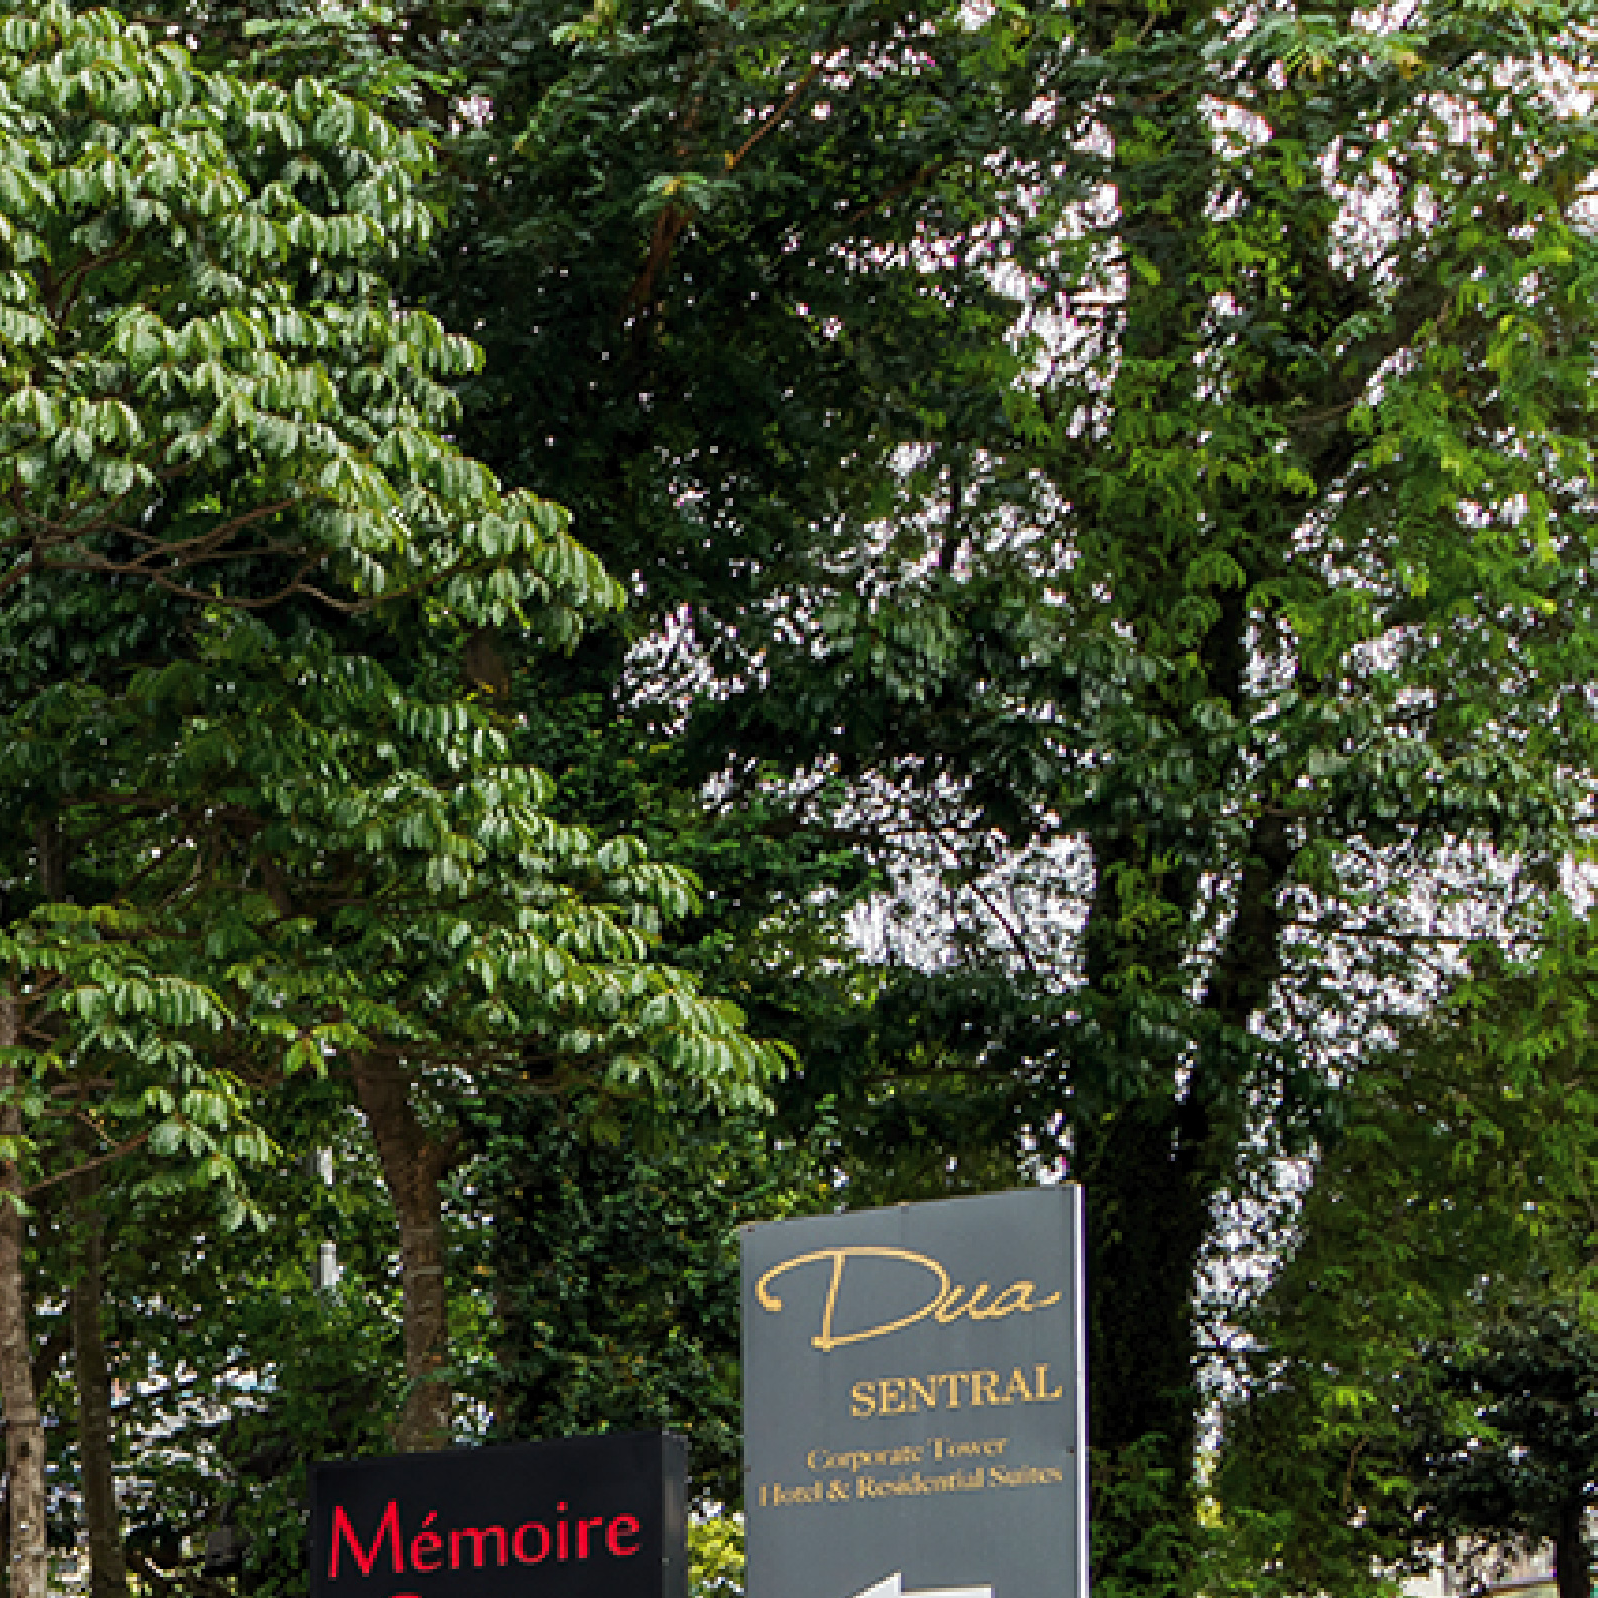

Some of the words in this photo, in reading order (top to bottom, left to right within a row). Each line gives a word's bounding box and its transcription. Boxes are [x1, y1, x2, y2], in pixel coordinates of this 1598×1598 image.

[754, 1245, 1062, 1352] Dua
[850, 1362, 1063, 1418] SENTRAL
[806, 1446, 925, 1473] Corporate
[928, 1437, 1010, 1462] Tower
[757, 1480, 824, 1507] Hotel
[825, 1479, 850, 1502] &
[855, 1466, 985, 1499] Residential
[988, 1464, 1063, 1488] Suites
[327, 1498, 641, 1580] Mémoire
